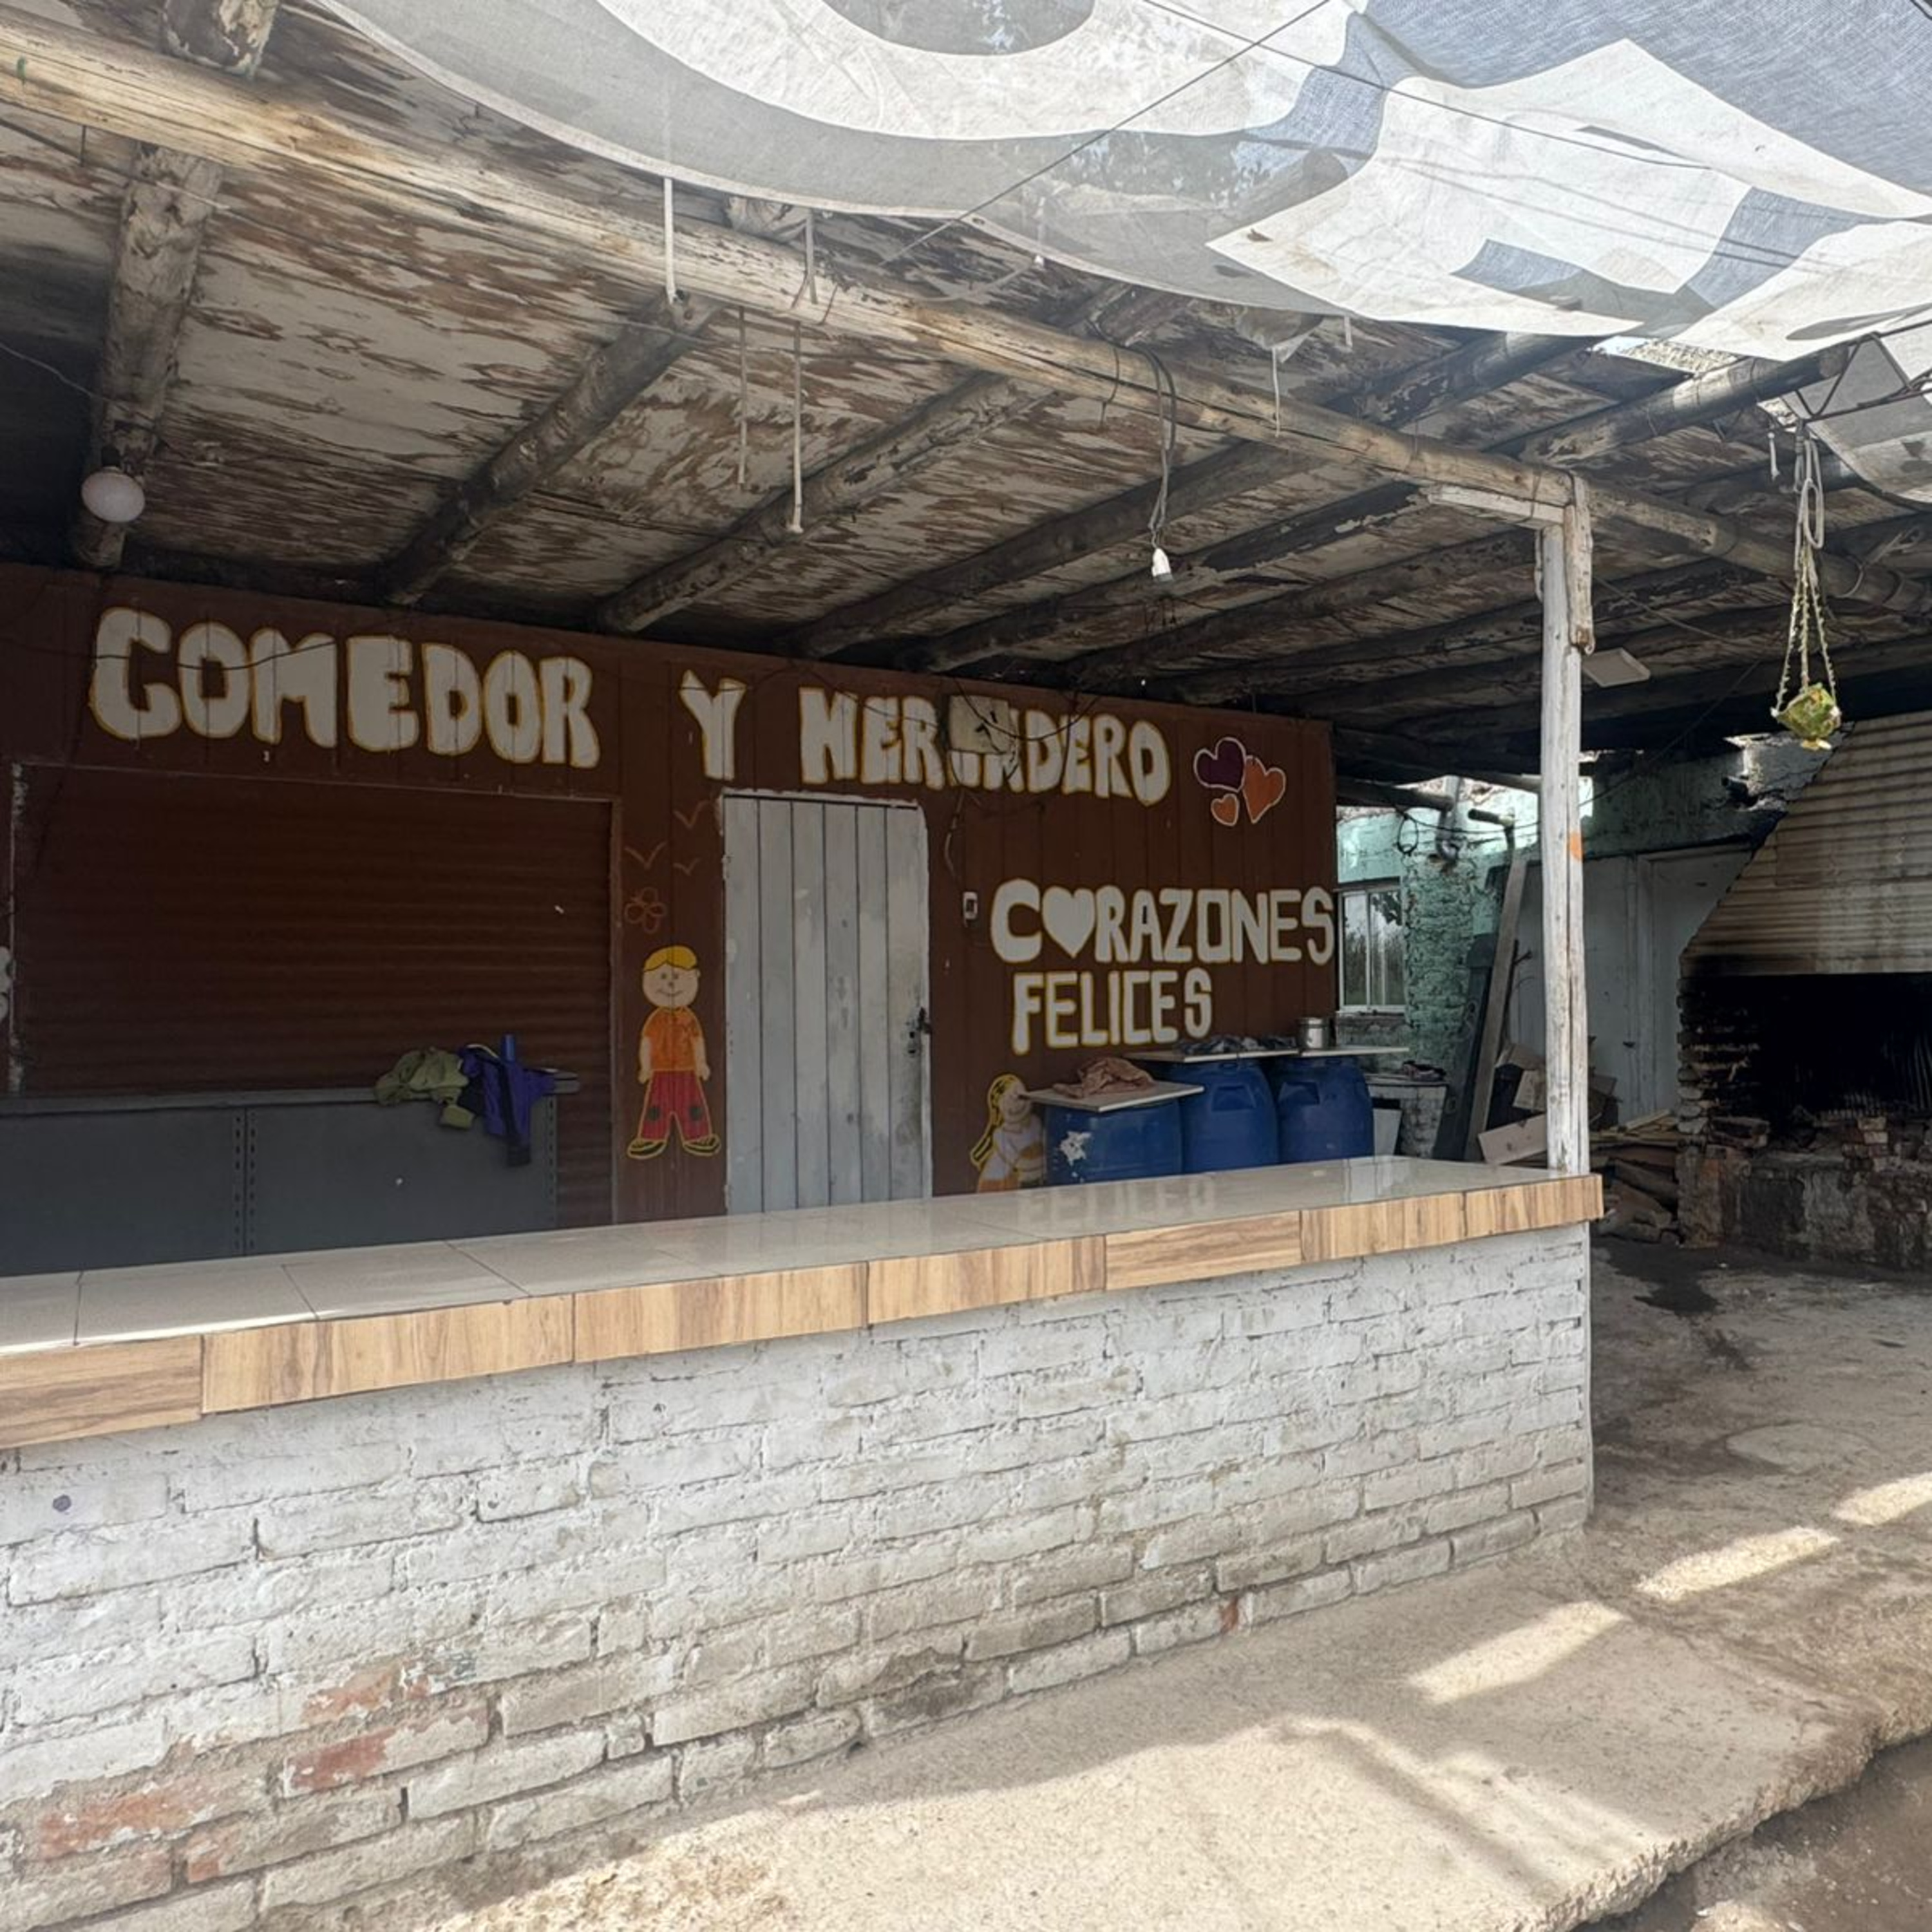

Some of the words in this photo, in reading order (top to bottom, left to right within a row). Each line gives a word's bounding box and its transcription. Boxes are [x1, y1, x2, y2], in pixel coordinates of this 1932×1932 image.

[89, 607, 600, 768] COMEDOR
[679, 670, 746, 781] Y
[1012, 968, 1213, 1055] FELICES
